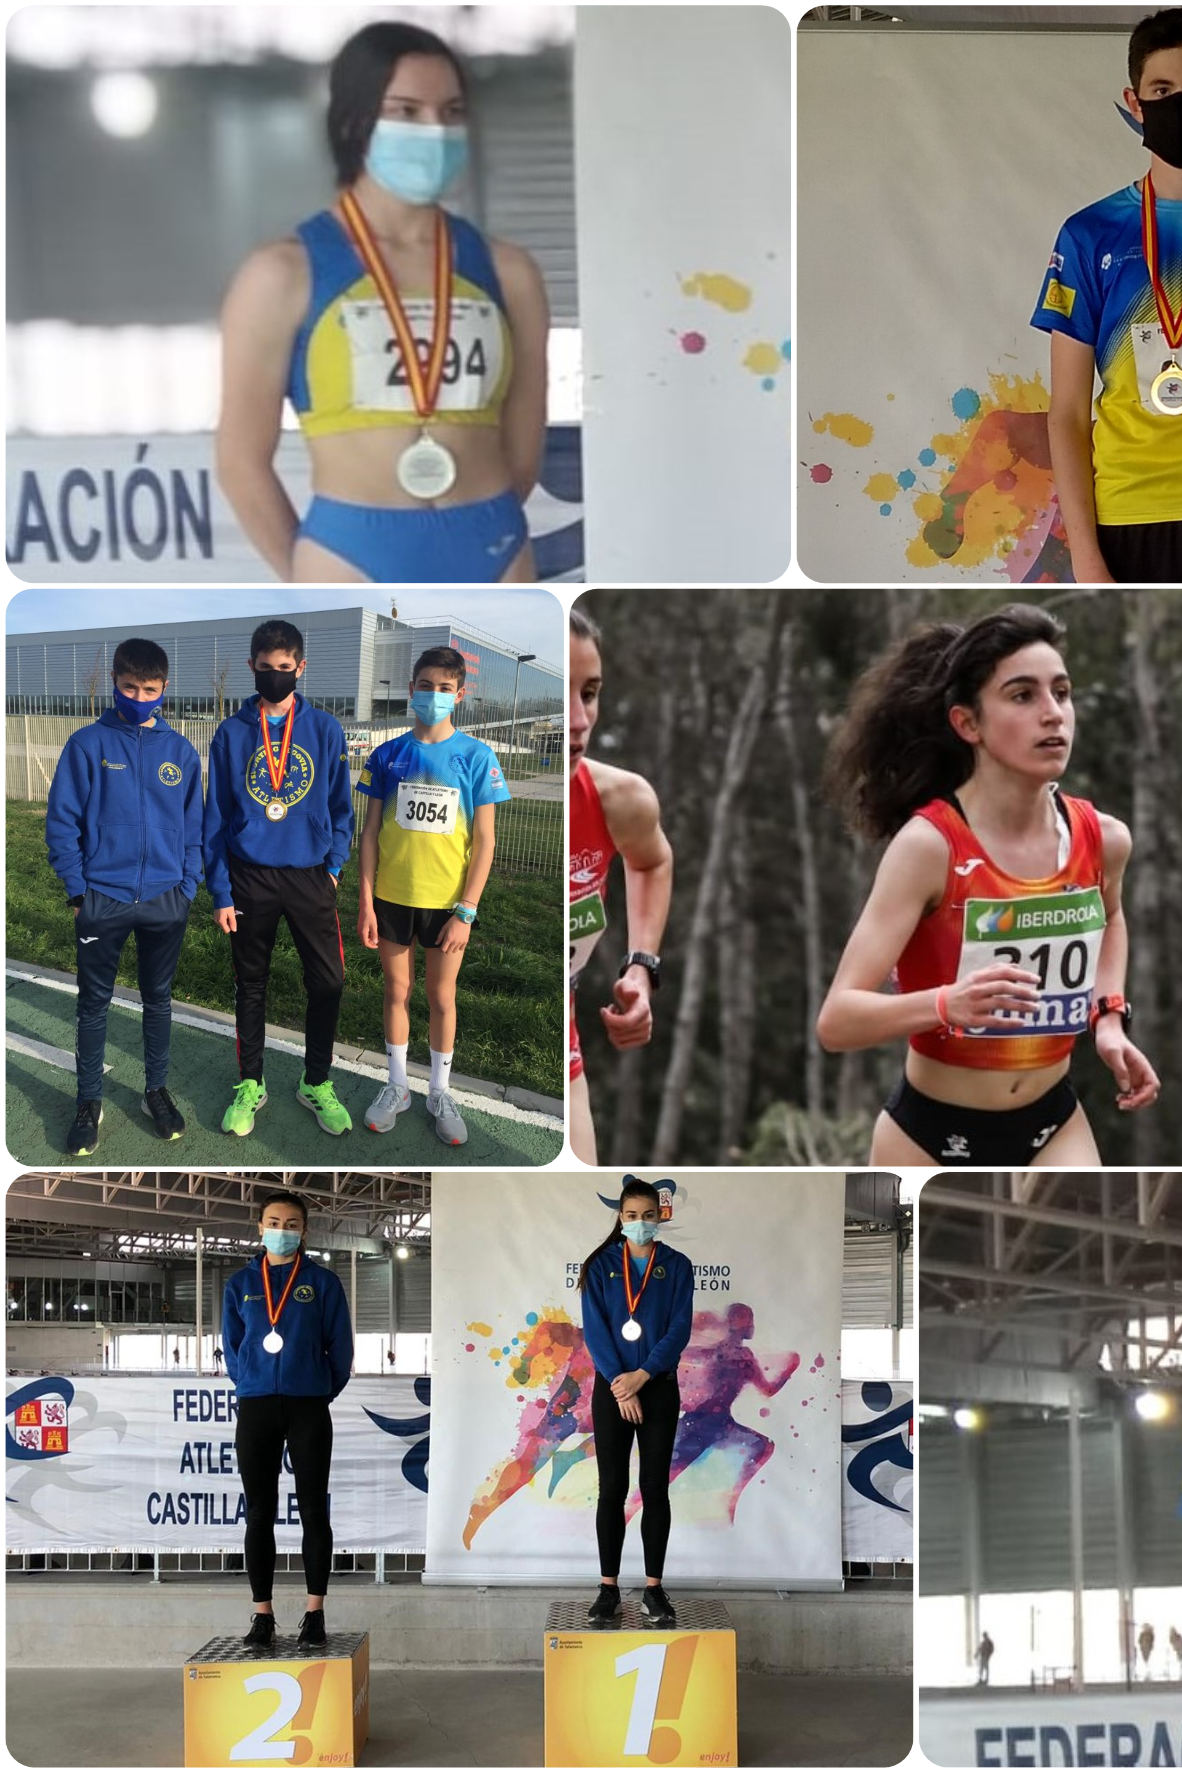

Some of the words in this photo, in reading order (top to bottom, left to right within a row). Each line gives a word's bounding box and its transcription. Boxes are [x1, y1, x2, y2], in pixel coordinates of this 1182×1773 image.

[6, 442, 214, 564] ACIÓN
[406, 800, 448, 824] 3054
[1017, 904, 1099, 929] IBERDROLA
[147, 1492, 249, 1525] CASTILLA
[318, 1751, 350, 1763] enjoy!
[700, 1751, 731, 1763] enjoy!
